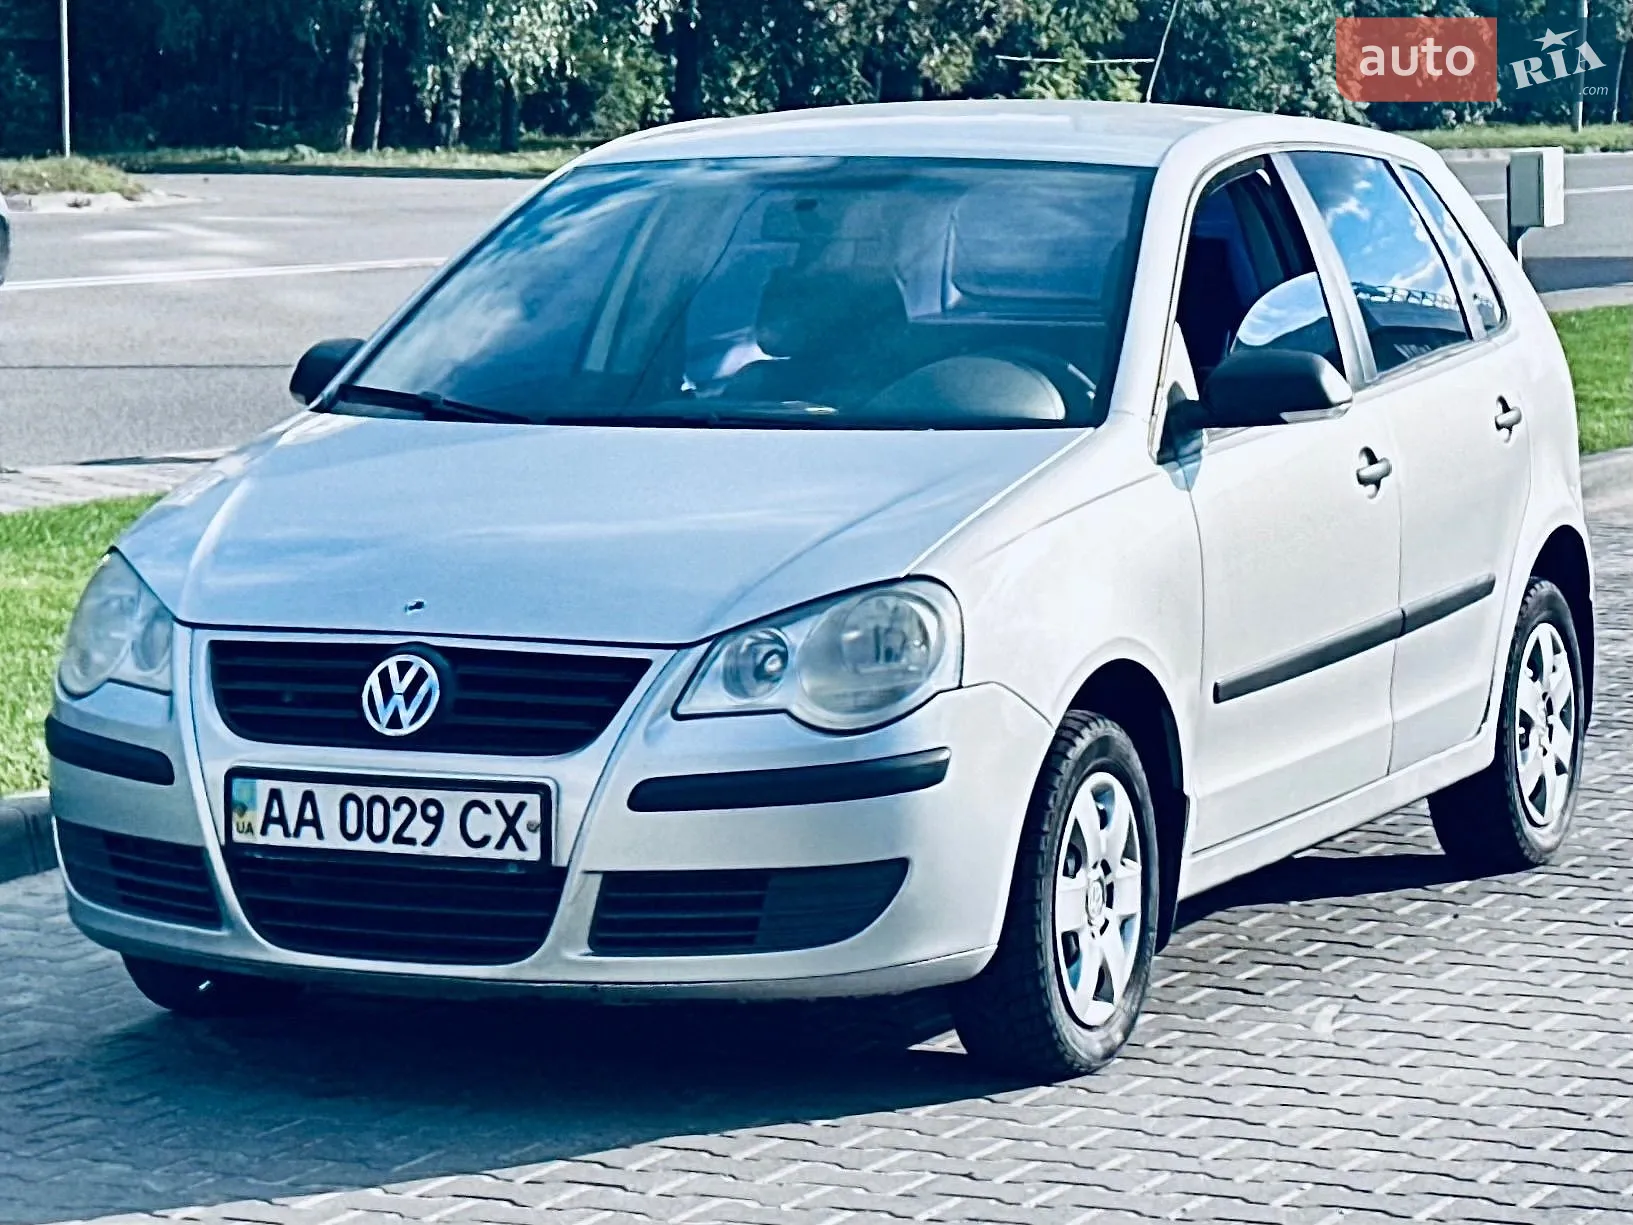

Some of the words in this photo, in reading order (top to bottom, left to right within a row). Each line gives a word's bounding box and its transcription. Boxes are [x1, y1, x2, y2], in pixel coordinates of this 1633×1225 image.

[236, 821, 255, 836] UA
[260, 787, 325, 841] AA
[339, 793, 445, 847] 0029
[459, 799, 529, 852] CX
